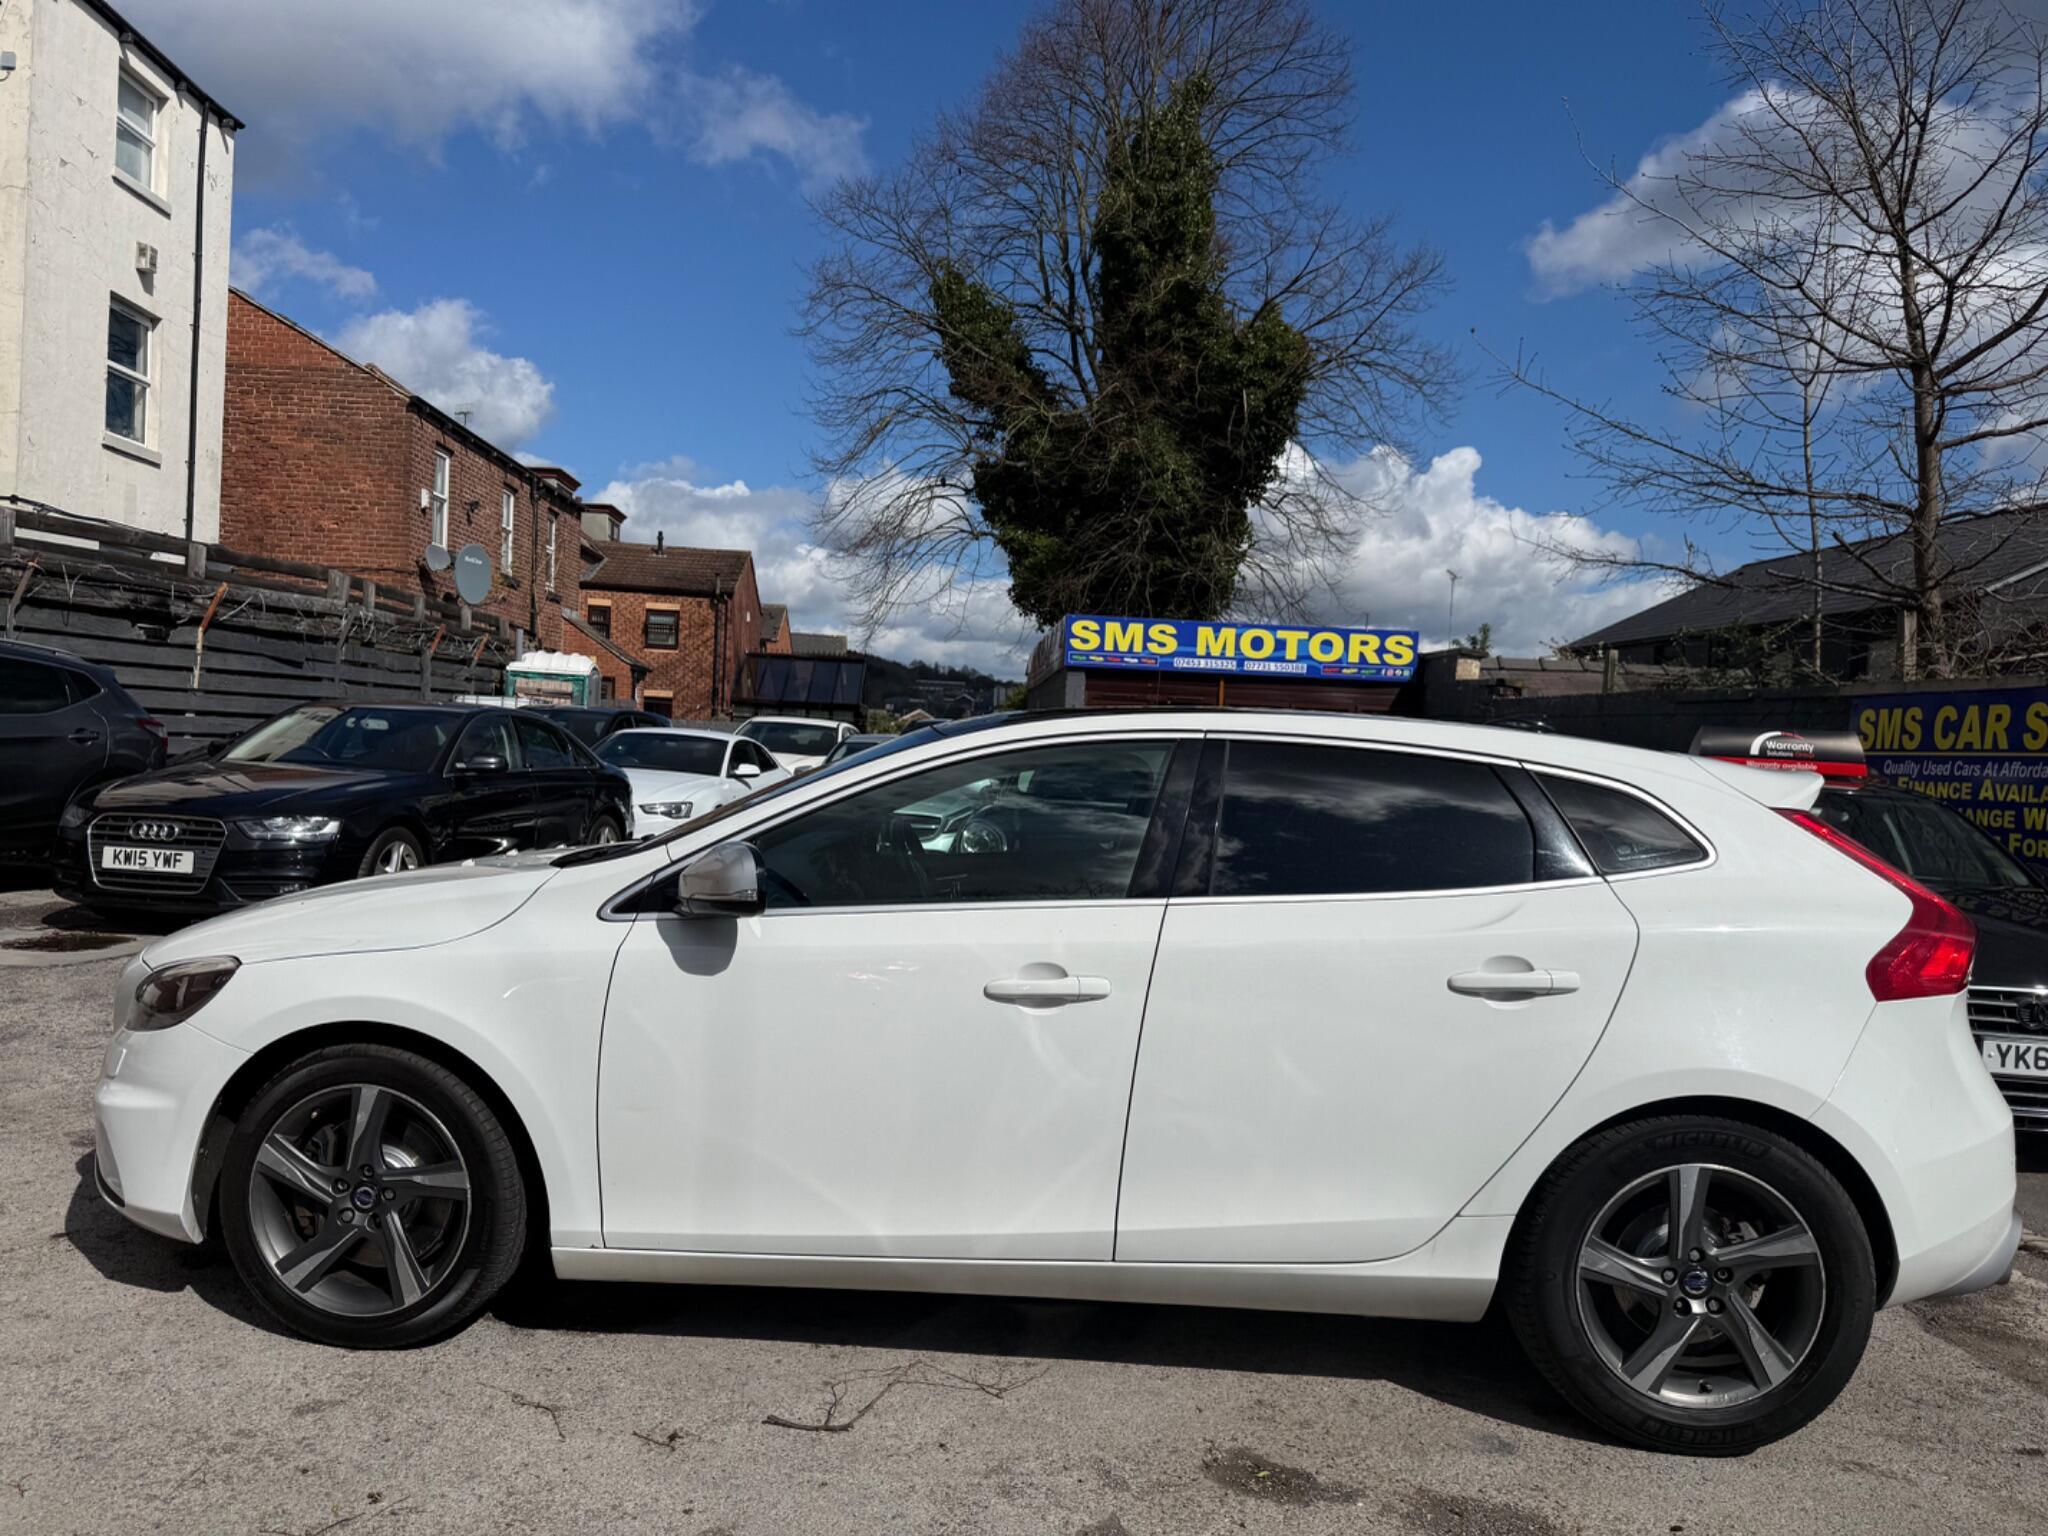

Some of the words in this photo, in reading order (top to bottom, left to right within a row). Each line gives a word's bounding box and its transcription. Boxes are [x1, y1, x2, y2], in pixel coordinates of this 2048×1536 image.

[1069, 619, 1178, 655] SMS
[1196, 626, 1415, 666] MOTORS
[1859, 706, 1923, 750] SMS
[1934, 704, 2011, 750] CAR
[1765, 740, 1815, 753] Warranty
[1883, 760, 1920, 778] Quality
[1922, 760, 1950, 775] Used
[1954, 760, 1981, 776] Cars
[1983, 761, 1999, 776] At
[2023, 807, 2048, 832] W
[112, 848, 149, 867] KW15
[152, 850, 184, 869] YWF
[1655, 1132, 1769, 1158] MICHELIN
